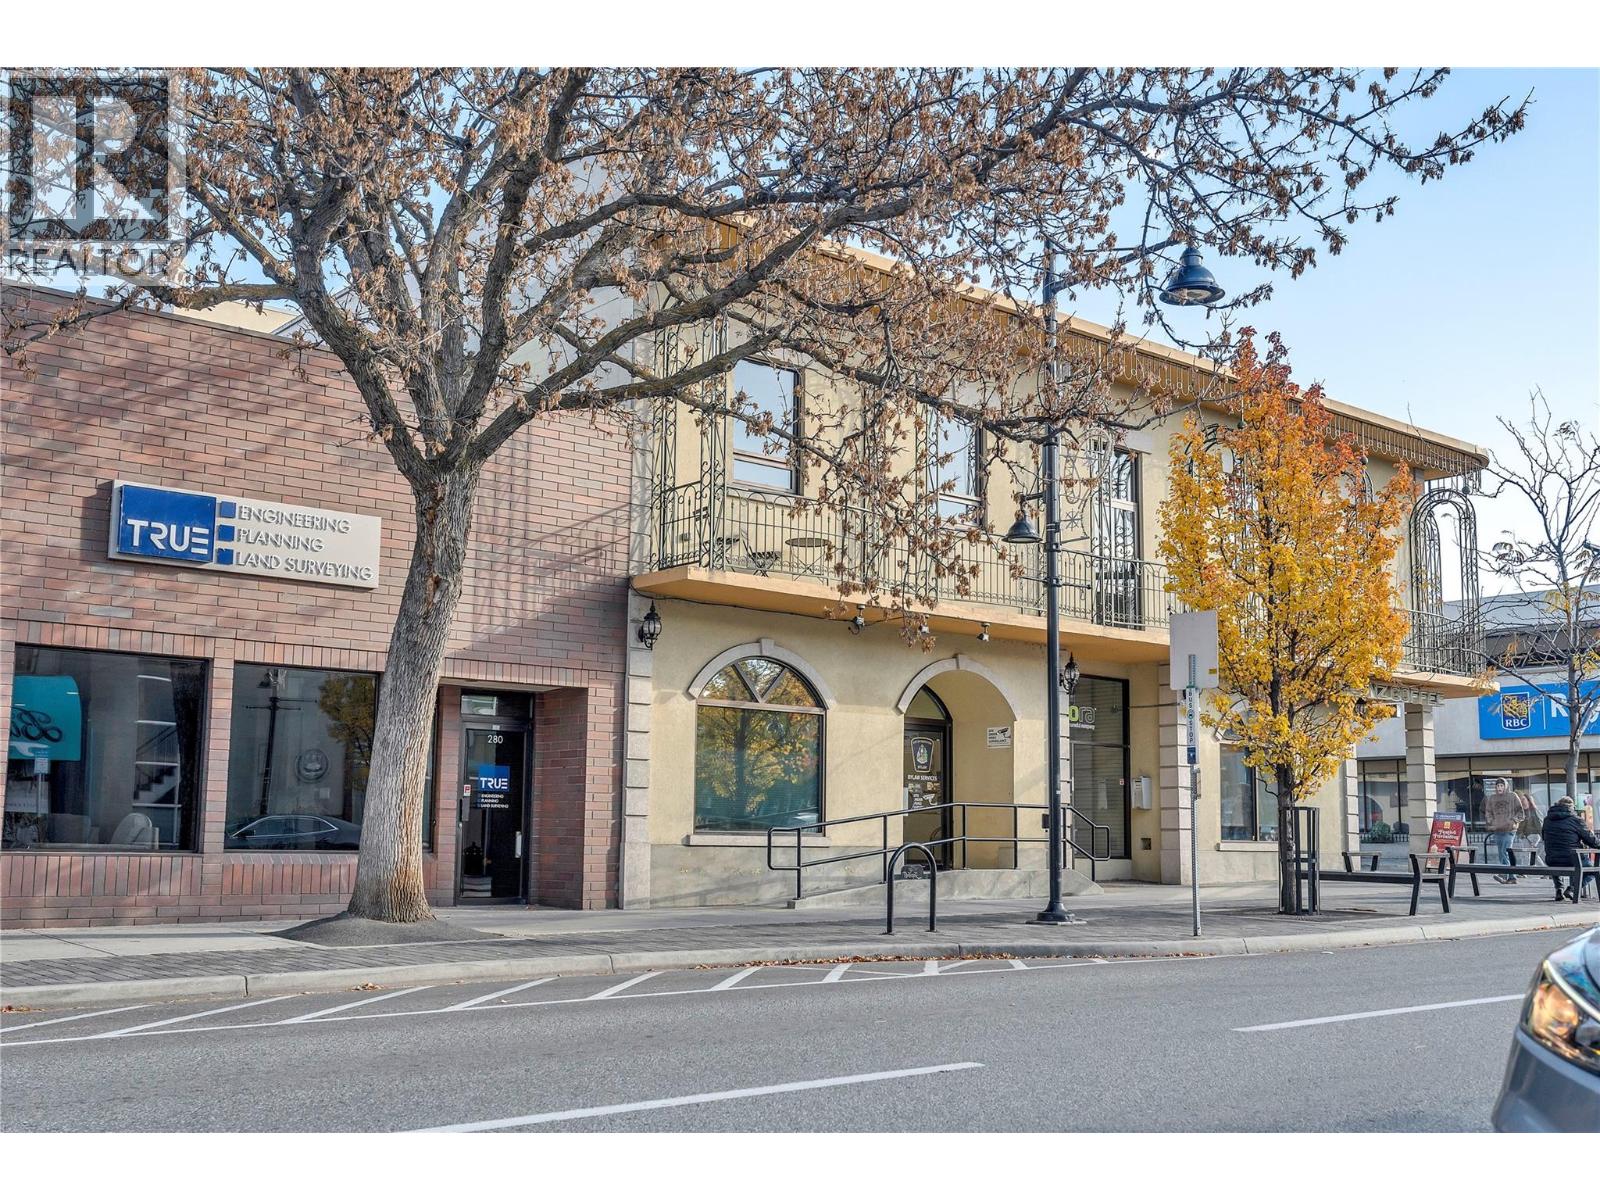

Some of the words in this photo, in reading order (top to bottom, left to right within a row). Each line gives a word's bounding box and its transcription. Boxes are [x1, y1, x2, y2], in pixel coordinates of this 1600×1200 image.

[238, 505, 351, 534] ENGINEERING
[127, 518, 209, 556] TRUE
[238, 527, 324, 552] PLANNING
[236, 551, 281, 571] LAND
[284, 557, 375, 582] SURVEYING
[1391, 686, 1445, 707] COFFEE
[1506, 719, 1528, 728] RBC
[487, 734, 504, 744] 280
[480, 777, 508, 789] TRUE
